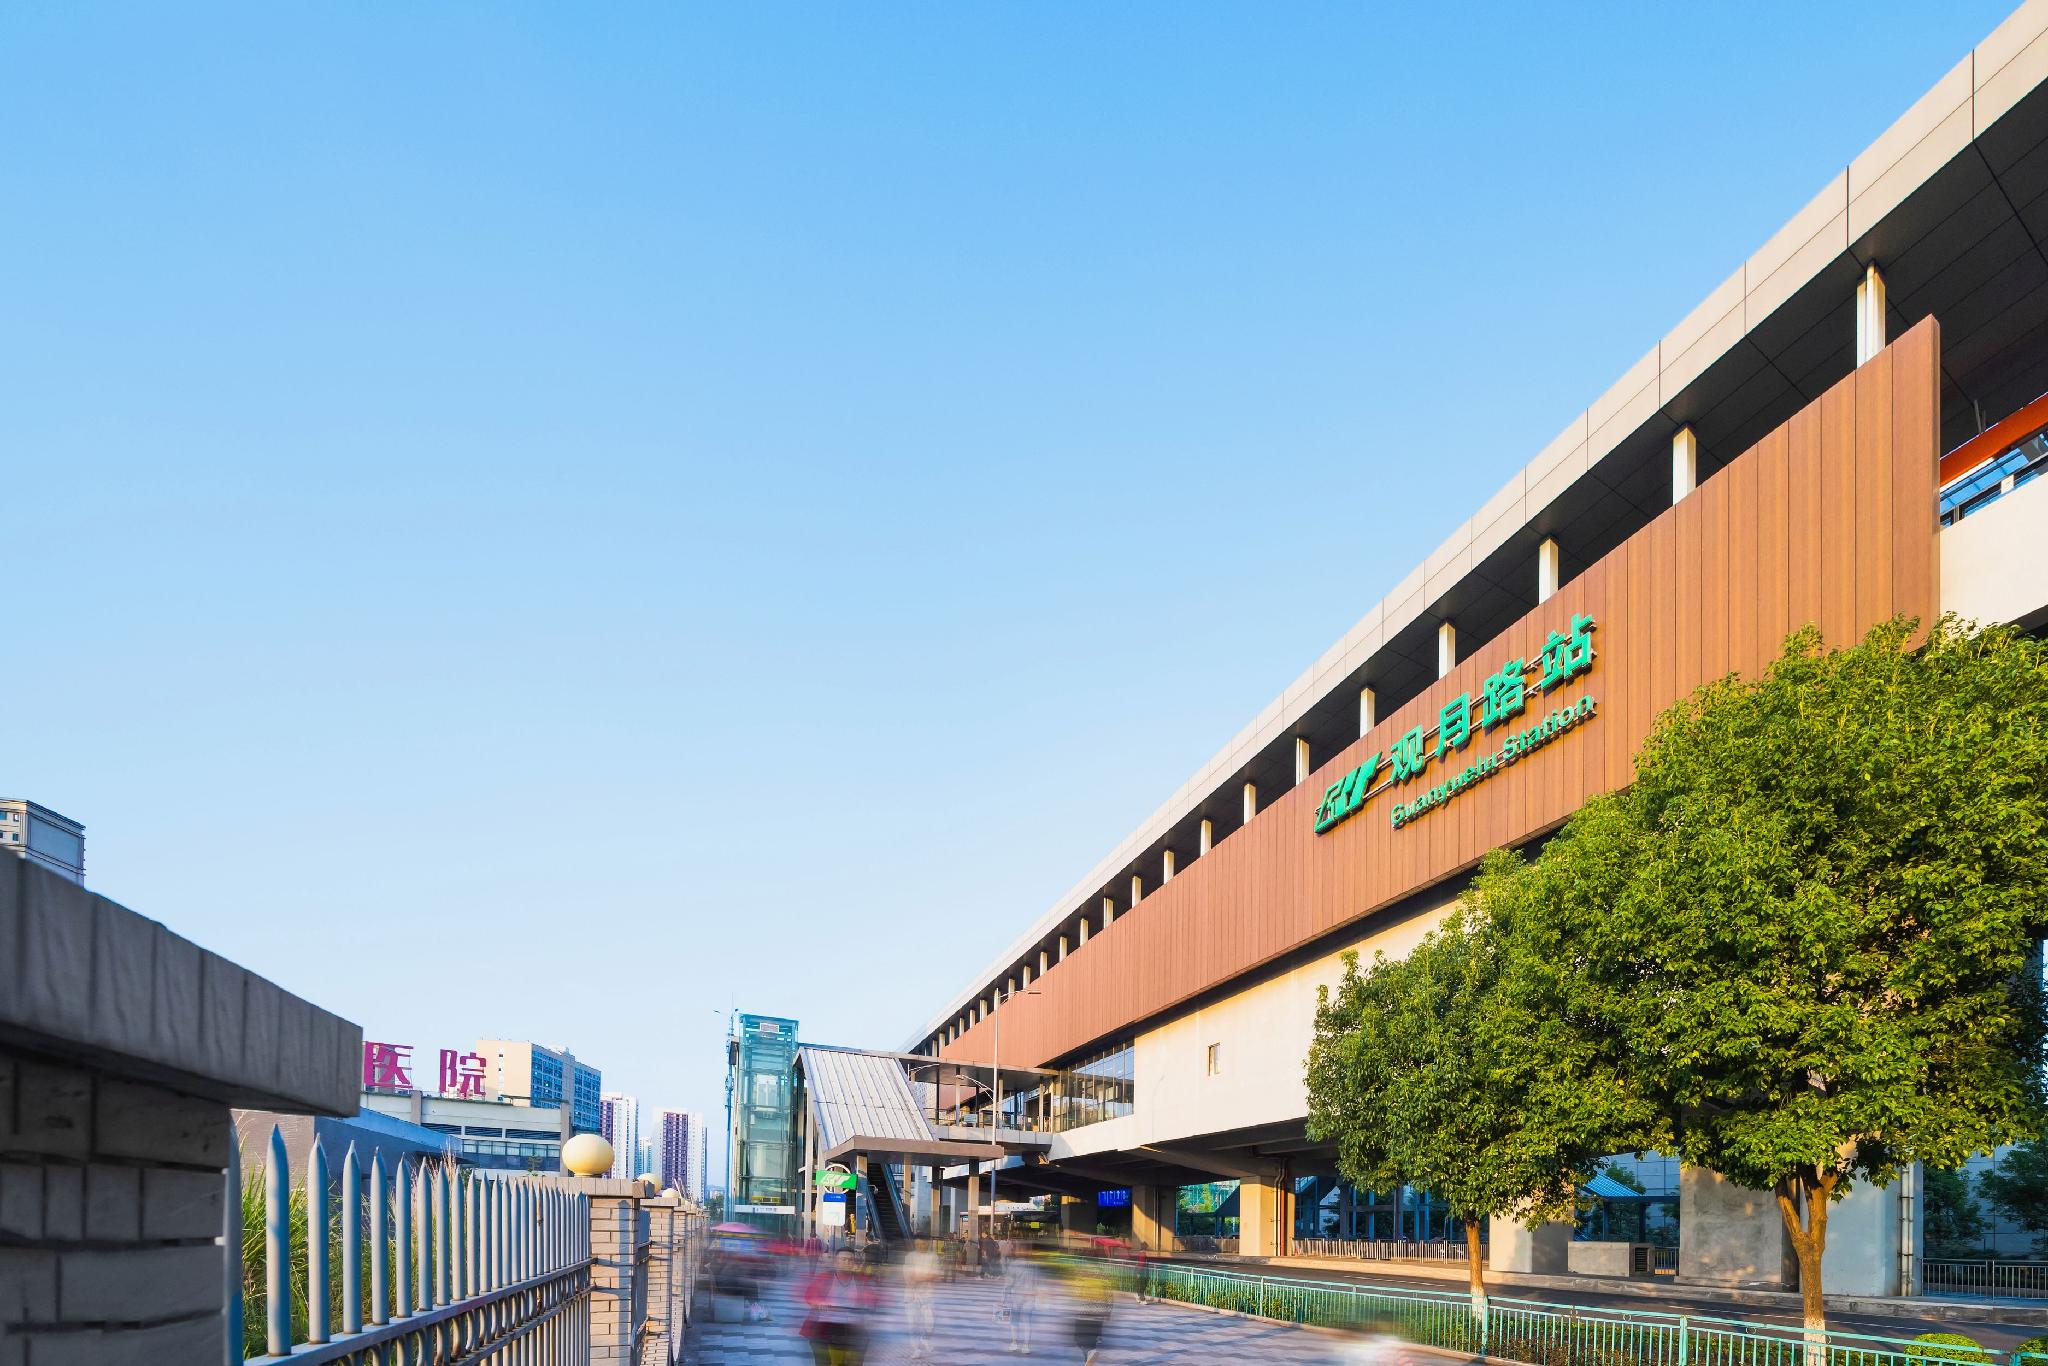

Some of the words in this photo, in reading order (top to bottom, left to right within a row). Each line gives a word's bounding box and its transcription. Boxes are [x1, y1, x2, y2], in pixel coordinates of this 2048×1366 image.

[1390, 613, 1592, 782] 观月路站
[1391, 752, 1497, 826] Guanyuelu
[1502, 694, 1593, 758] Station
[364, 1042, 486, 1097] 医院
